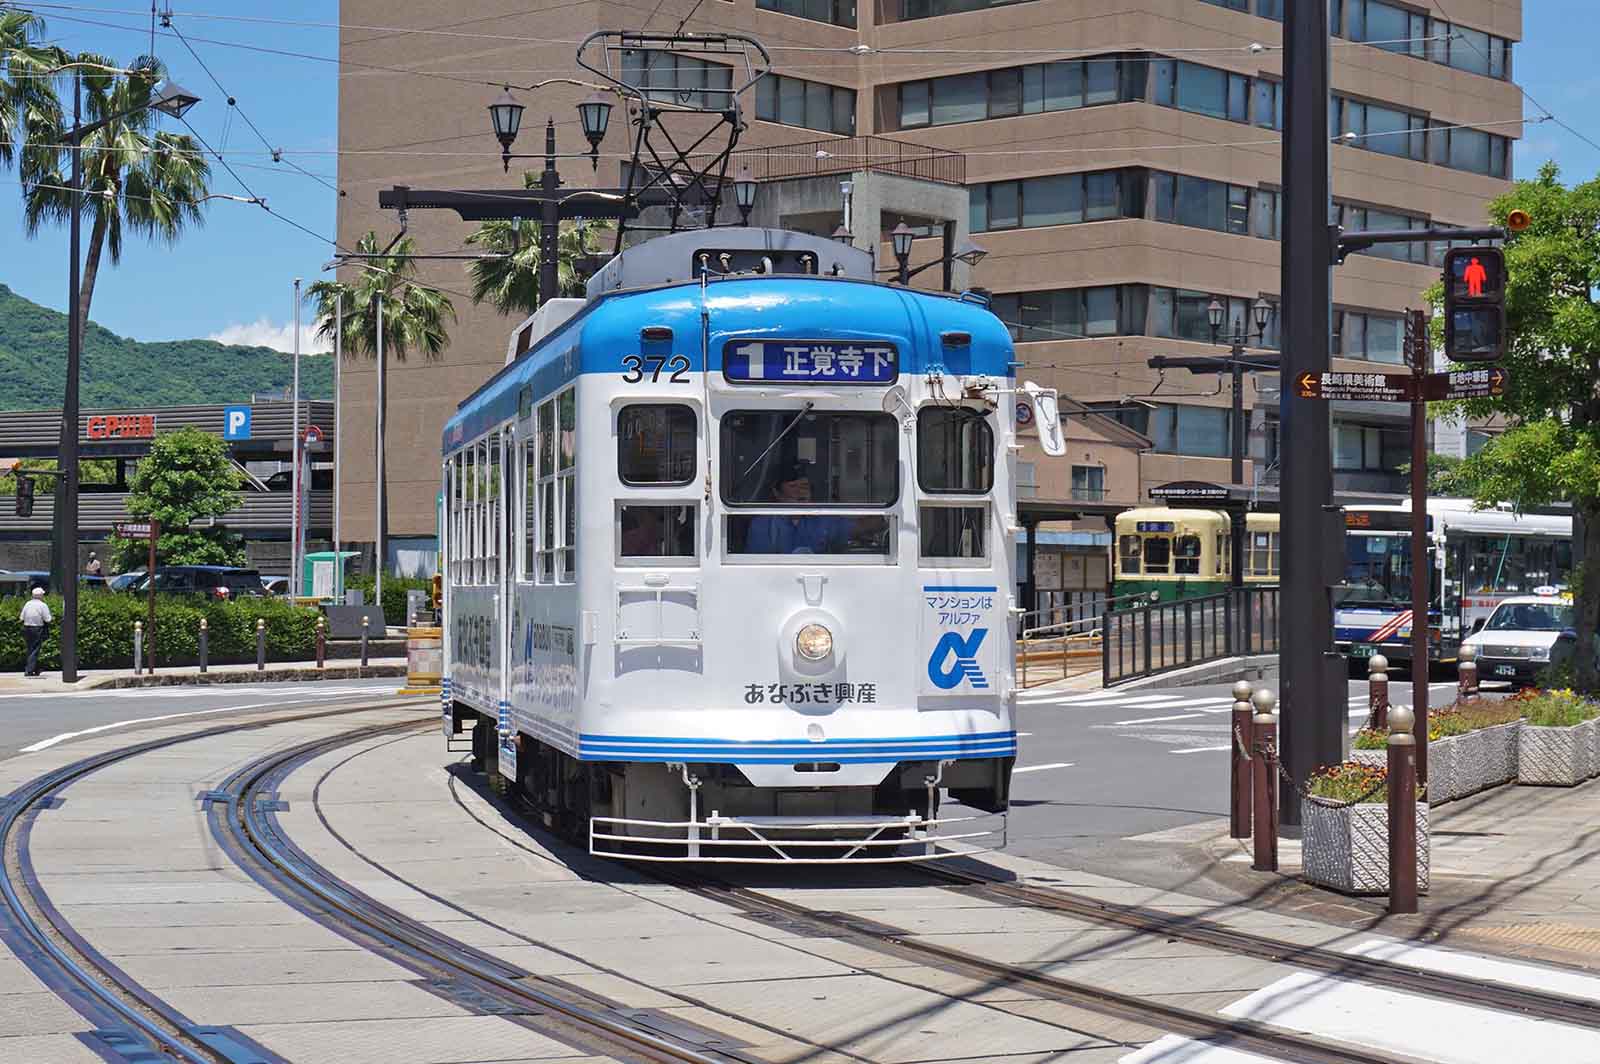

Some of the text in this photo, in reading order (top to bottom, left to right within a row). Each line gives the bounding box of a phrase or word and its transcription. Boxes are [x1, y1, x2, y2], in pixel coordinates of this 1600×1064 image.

[621, 354, 691, 384] 372
[735, 342, 895, 378] 1 正覚寺下
[1321, 373, 1386, 387] 長崎県美術館
[229, 411, 246, 435] P
[925, 596, 993, 610] マンションは
[938, 612, 981, 625] アルファ
[743, 682, 877, 704] あなぶき興産
